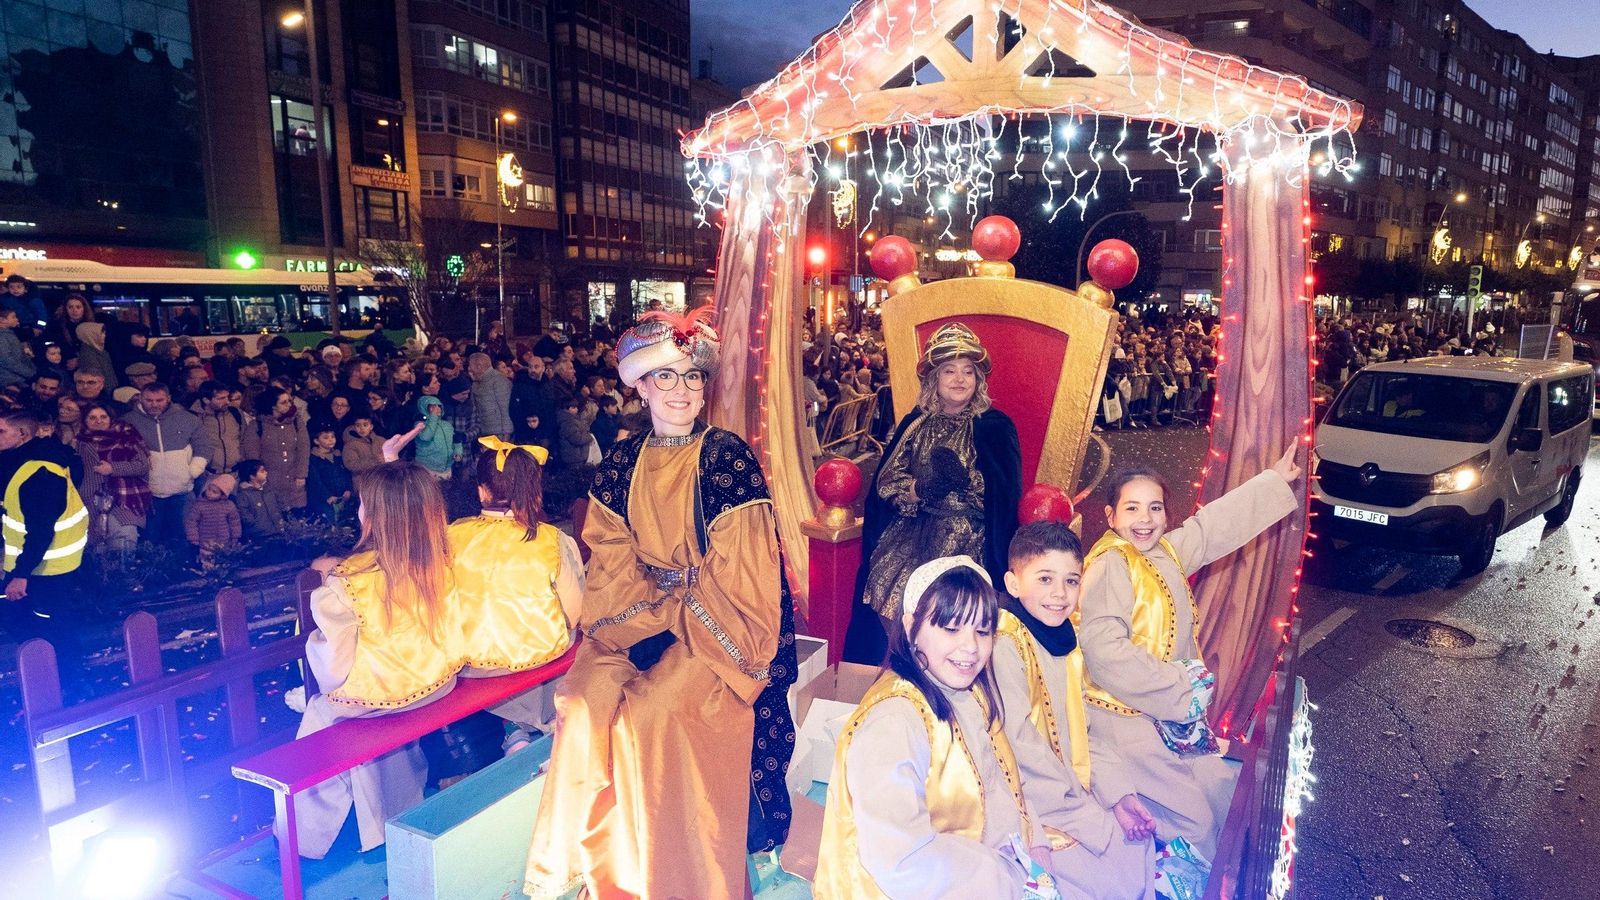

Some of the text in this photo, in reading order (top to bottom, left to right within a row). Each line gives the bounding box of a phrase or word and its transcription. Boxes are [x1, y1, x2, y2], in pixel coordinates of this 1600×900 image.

[286, 260, 363, 273] FARMCIA
[300, 284, 331, 292] avanz
[1340, 507, 1386, 524] 7015 JFC
